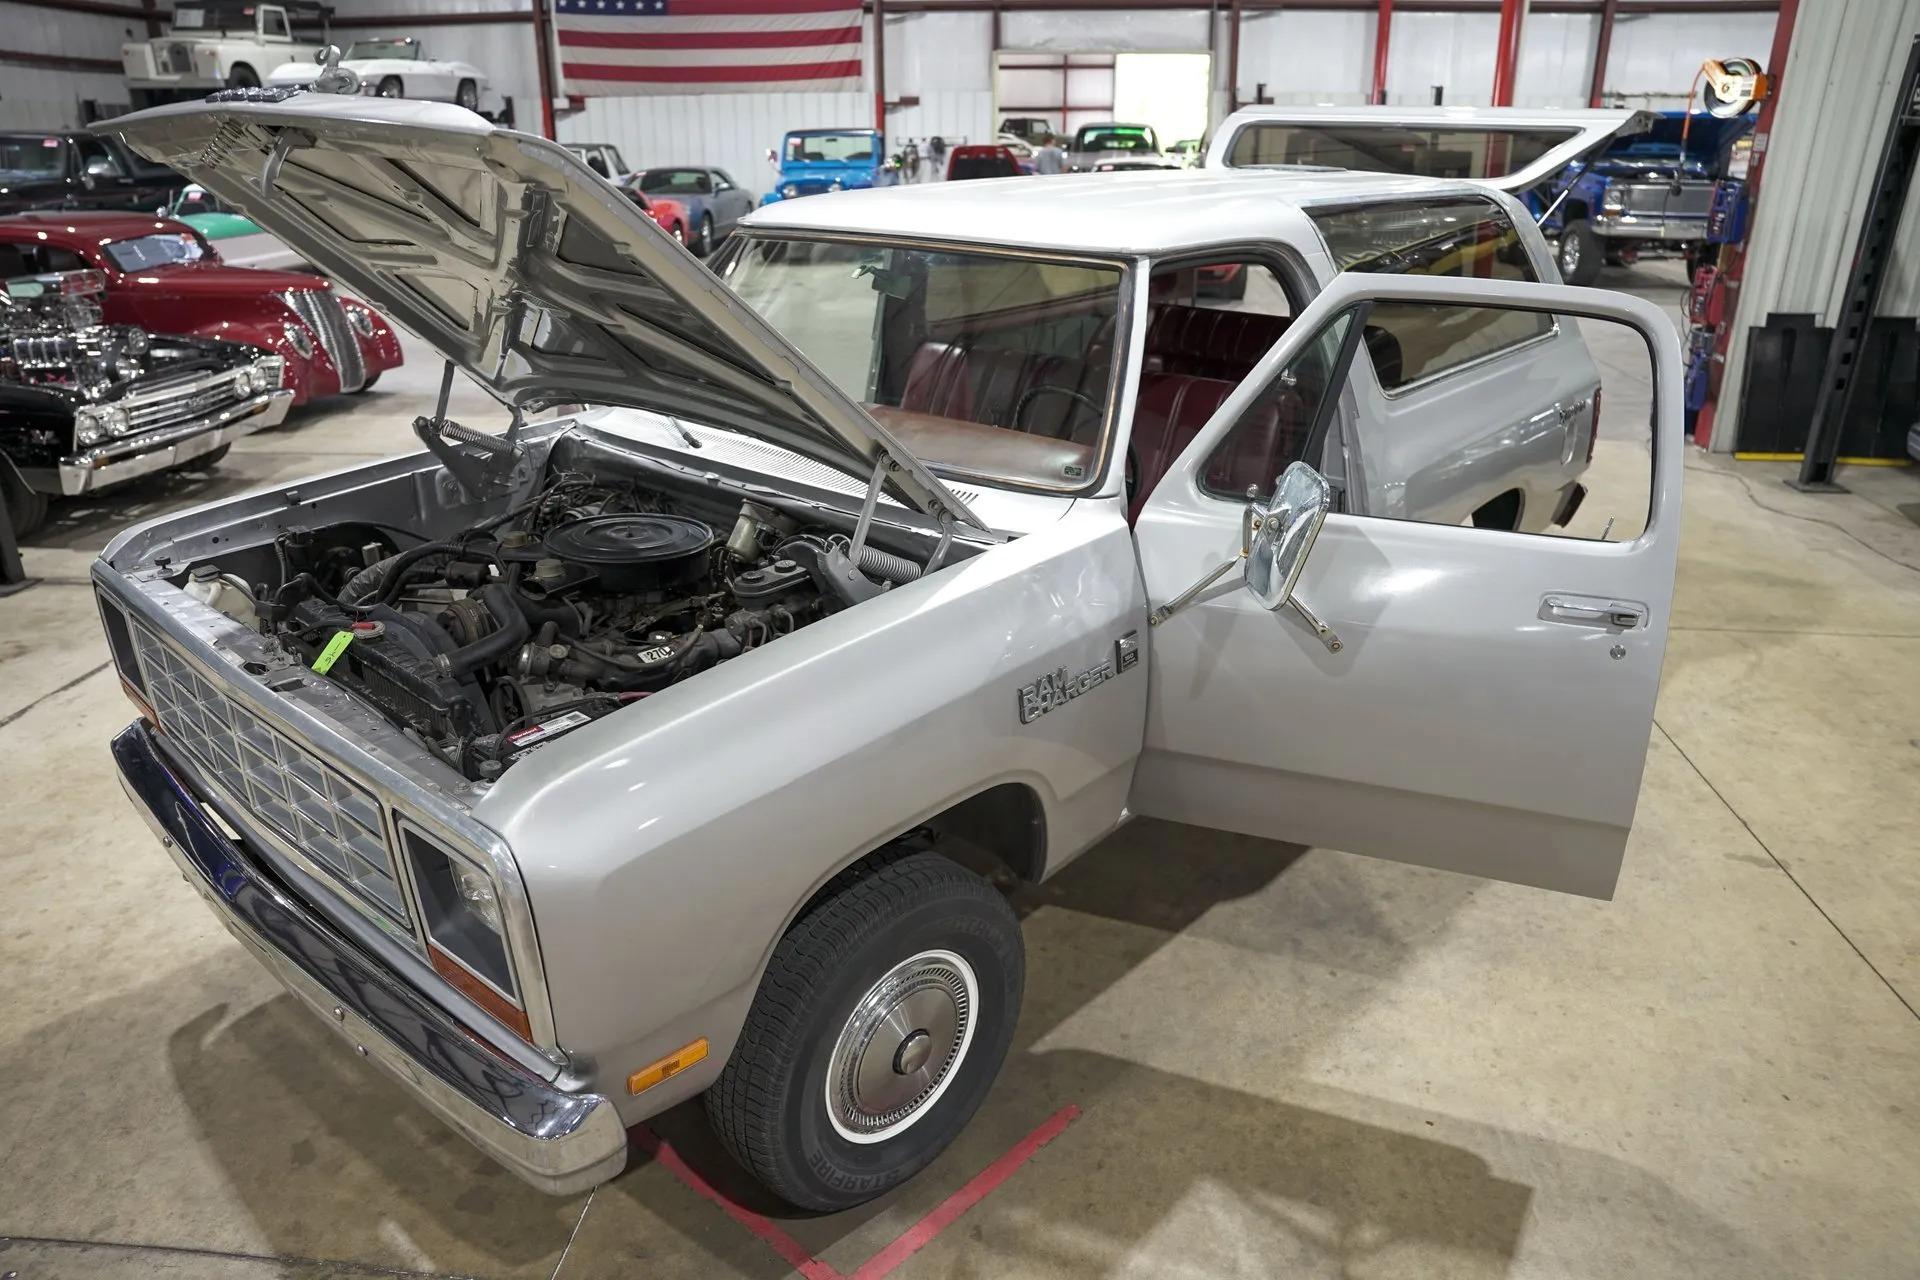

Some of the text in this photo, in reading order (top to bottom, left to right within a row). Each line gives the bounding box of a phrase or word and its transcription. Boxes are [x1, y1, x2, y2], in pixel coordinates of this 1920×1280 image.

[1019, 666, 1069, 705] RAM
[1021, 662, 1115, 724] CHARGER
[809, 1149, 899, 1193] STARFIRE
